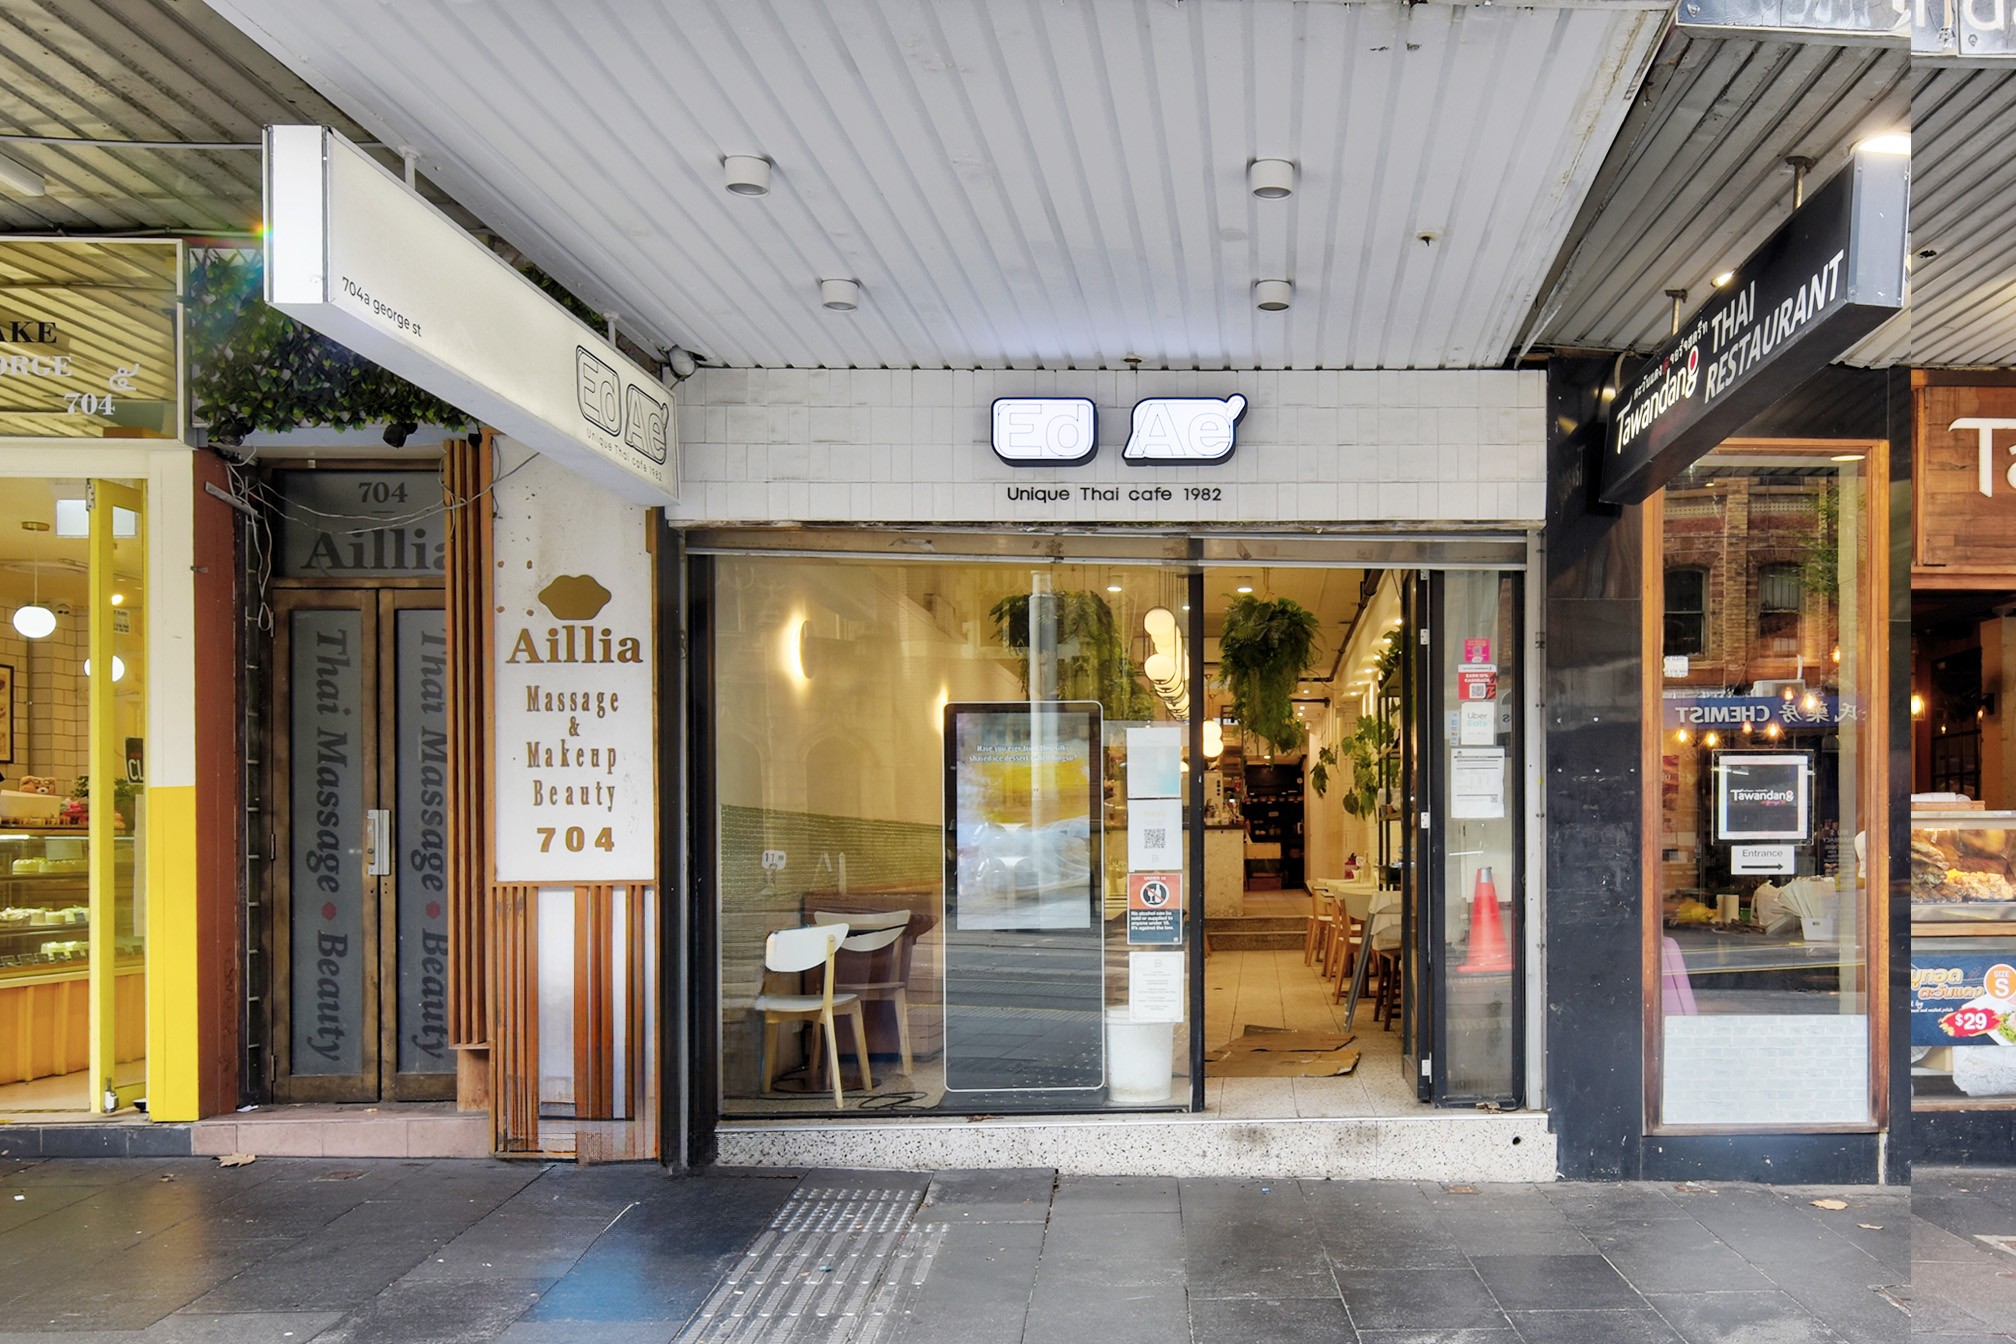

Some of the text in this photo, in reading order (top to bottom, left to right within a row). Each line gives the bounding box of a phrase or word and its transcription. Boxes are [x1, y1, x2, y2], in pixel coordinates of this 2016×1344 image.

[342, 276, 422, 338] 704a george st
[1711, 280, 1756, 354] THAI
[1704, 249, 1844, 404] RESTAURANT
[64, 392, 116, 415] 704
[1616, 345, 1699, 454] Tawandang
[991, 397, 1097, 463] Ed
[1948, 417, 2016, 497] T
[358, 482, 408, 503] 704
[1007, 487, 1222, 503] Unique Thai cafe 1982
[505, 625, 644, 664] Aillia
[526, 685, 619, 718] Massage
[1467, 712, 1487, 720] Uber
[568, 716, 580, 737] &
[1466, 719, 1488, 727] Eats
[526, 739, 617, 774] Makeup
[533, 780, 616, 812] Beauty
[1729, 788, 1795, 802] Tawandang
[306, 629, 352, 1062] Thai Massage Beauty
[410, 628, 448, 1060] Thai Massage Beauty
[537, 826, 615, 852] 704
[1742, 848, 1783, 858] Entrance
[1994, 978, 2010, 997] S
[1955, 1012, 1987, 1030] $29
